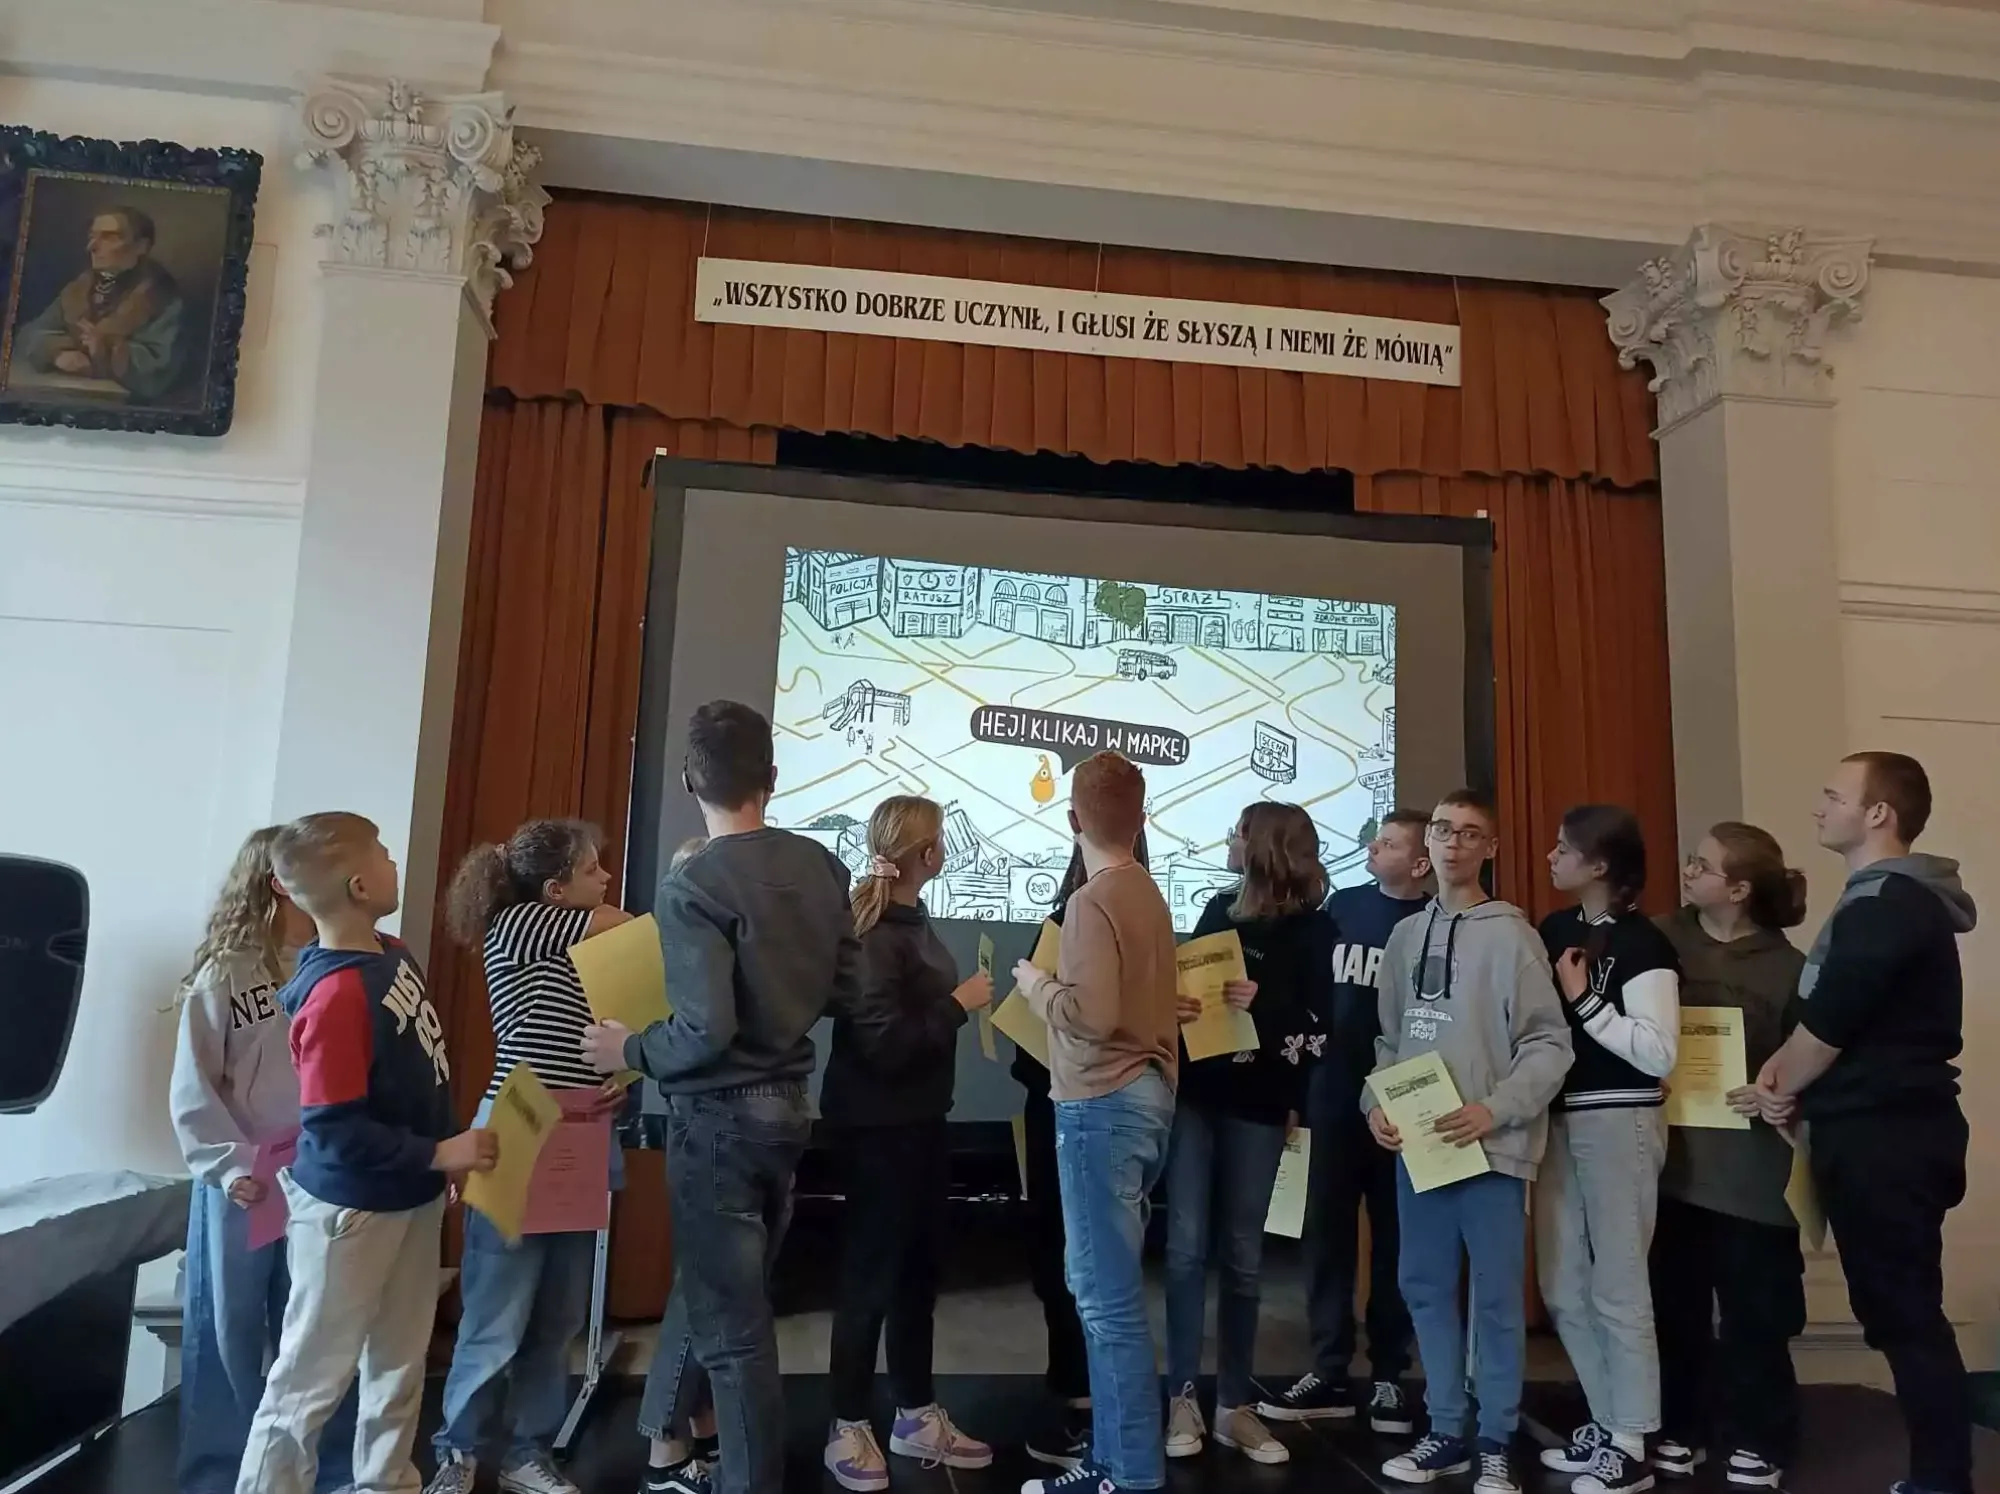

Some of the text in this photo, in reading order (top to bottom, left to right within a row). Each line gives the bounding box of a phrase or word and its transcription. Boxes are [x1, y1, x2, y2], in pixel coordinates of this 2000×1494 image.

[712, 280, 848, 314] „WSZYSTKO
[855, 291, 946, 322] DOBRZE
[953, 299, 1050, 335] UCZYNIŁ,
[1057, 310, 1064, 334] I
[1072, 311, 1135, 339] GŁUSI
[1142, 310, 1170, 342] ŻE
[1176, 318, 1259, 357] SŁYSZĄ
[1265, 326, 1273, 350] I
[1279, 328, 1335, 356] NIEMI
[1342, 327, 1368, 359] ŻE
[829, 580, 874, 596] POLICJA
[902, 591, 954, 604] RATUSZ
[979, 710, 1188, 763] HEJ! KLIKAJ W MAPKĘ!
[230, 979, 286, 1030] NE
